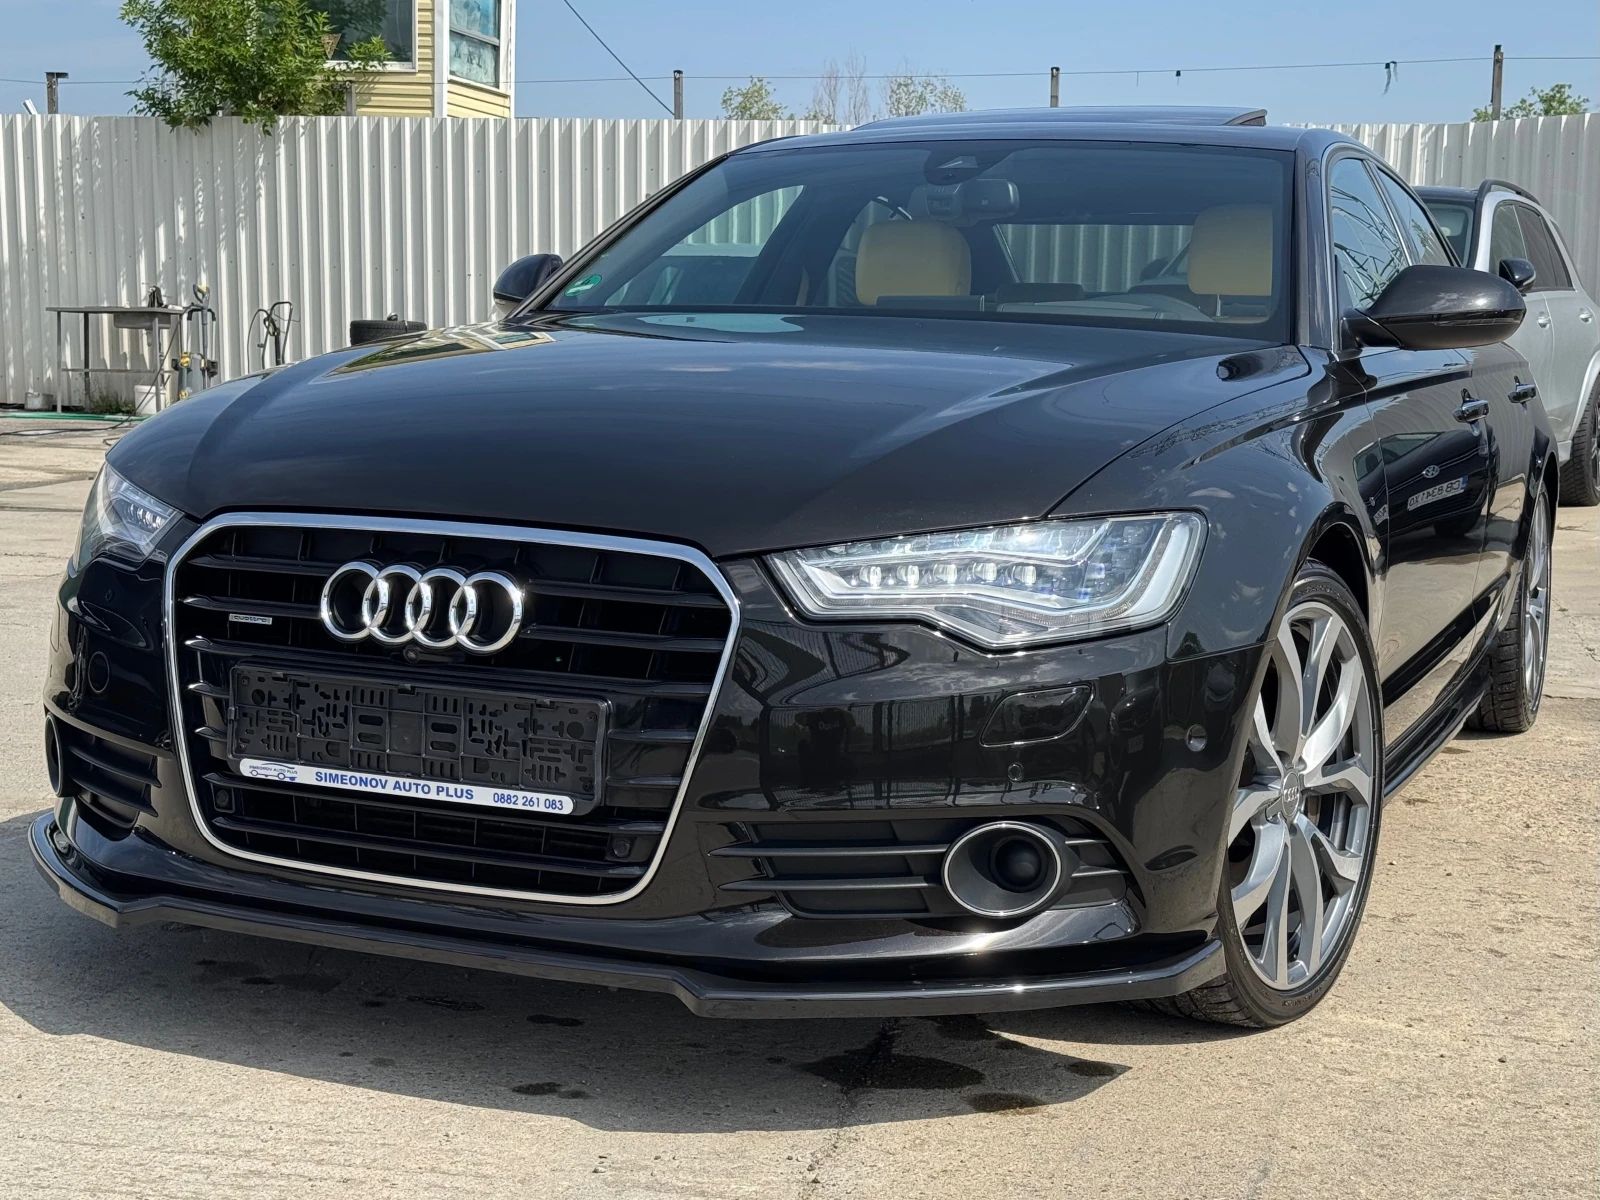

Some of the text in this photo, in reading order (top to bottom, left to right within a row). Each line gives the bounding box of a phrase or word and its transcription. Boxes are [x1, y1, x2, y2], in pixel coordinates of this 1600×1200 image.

[315, 771, 564, 811] SIMEONOV AUTO PLUS 0882 261 083
